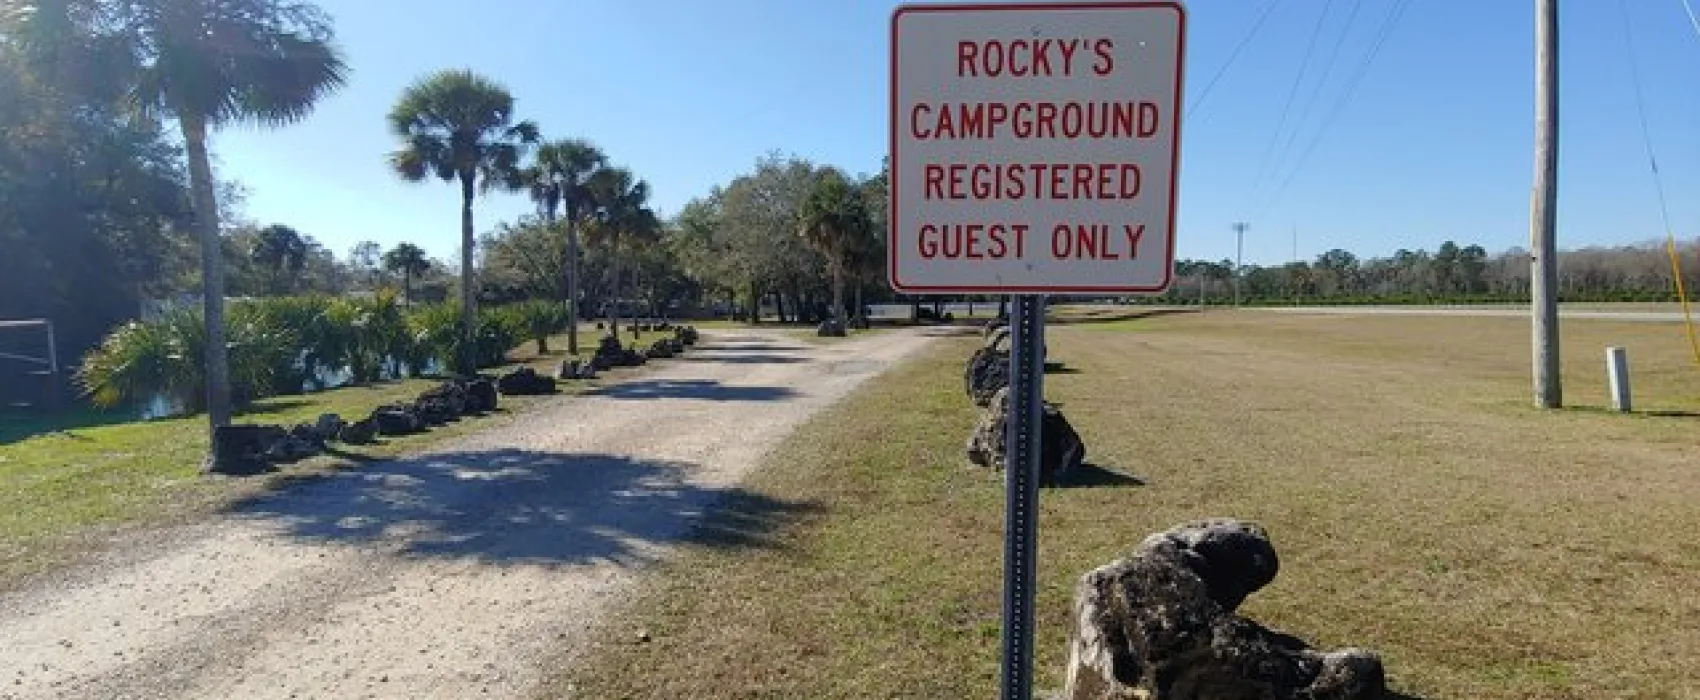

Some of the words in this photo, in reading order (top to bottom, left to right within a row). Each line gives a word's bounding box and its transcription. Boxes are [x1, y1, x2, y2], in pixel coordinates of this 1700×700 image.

[957, 38, 1114, 77] ROCKY'S
[911, 102, 1159, 139] CAMPGROUND
[924, 163, 1141, 200] REGISTERED
[918, 223, 1029, 260] GUEST
[1051, 223, 1146, 260] ONLY
